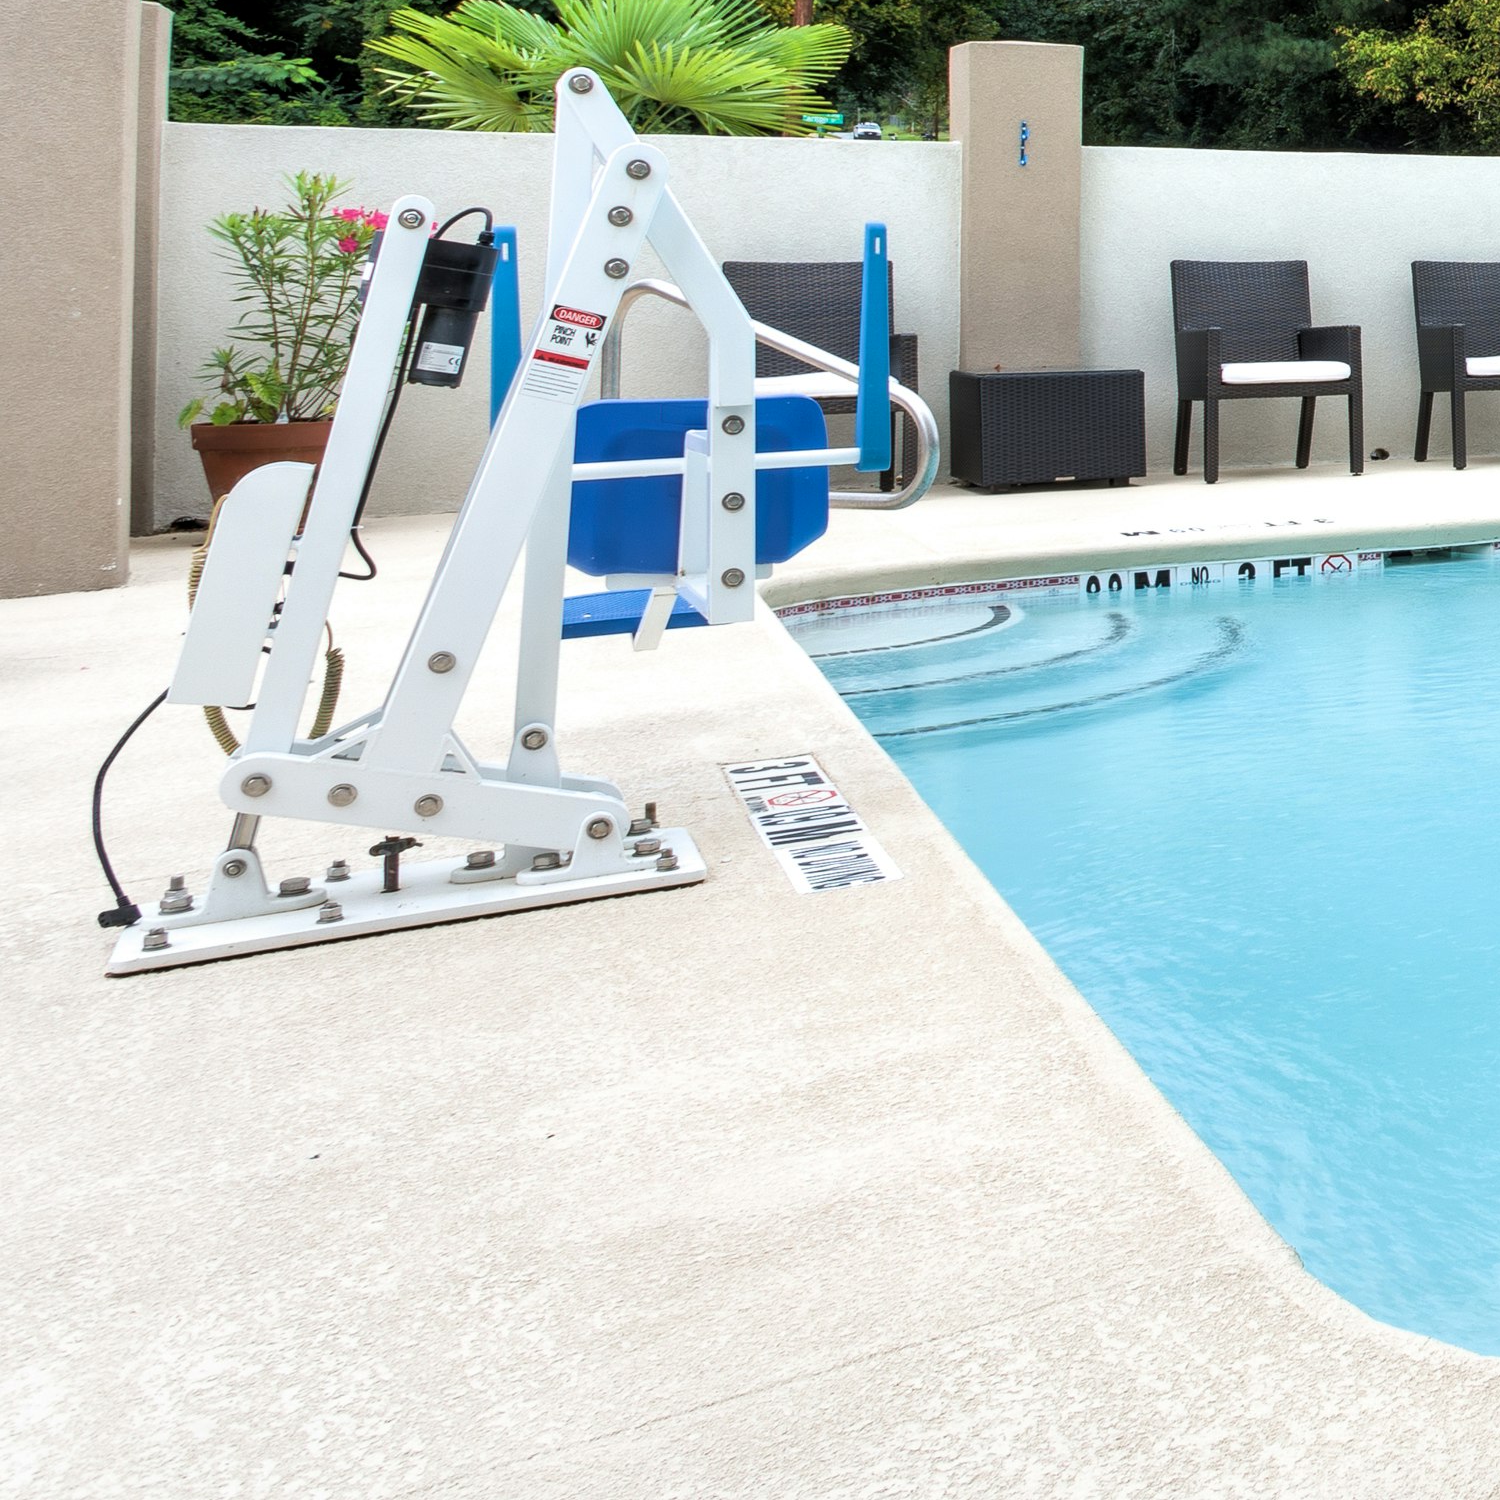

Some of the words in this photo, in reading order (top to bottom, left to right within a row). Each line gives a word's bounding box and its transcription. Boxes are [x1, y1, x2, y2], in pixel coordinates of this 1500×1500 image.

[559, 309, 597, 326] DANGER
[553, 324, 577, 337] PINCH
[550, 334, 573, 347] POINT
[729, 761, 811, 774] 3
[735, 772, 825, 792] FT
[766, 820, 863, 846] M
[788, 840, 864, 859] NO
[797, 853, 886, 890] DIVING
